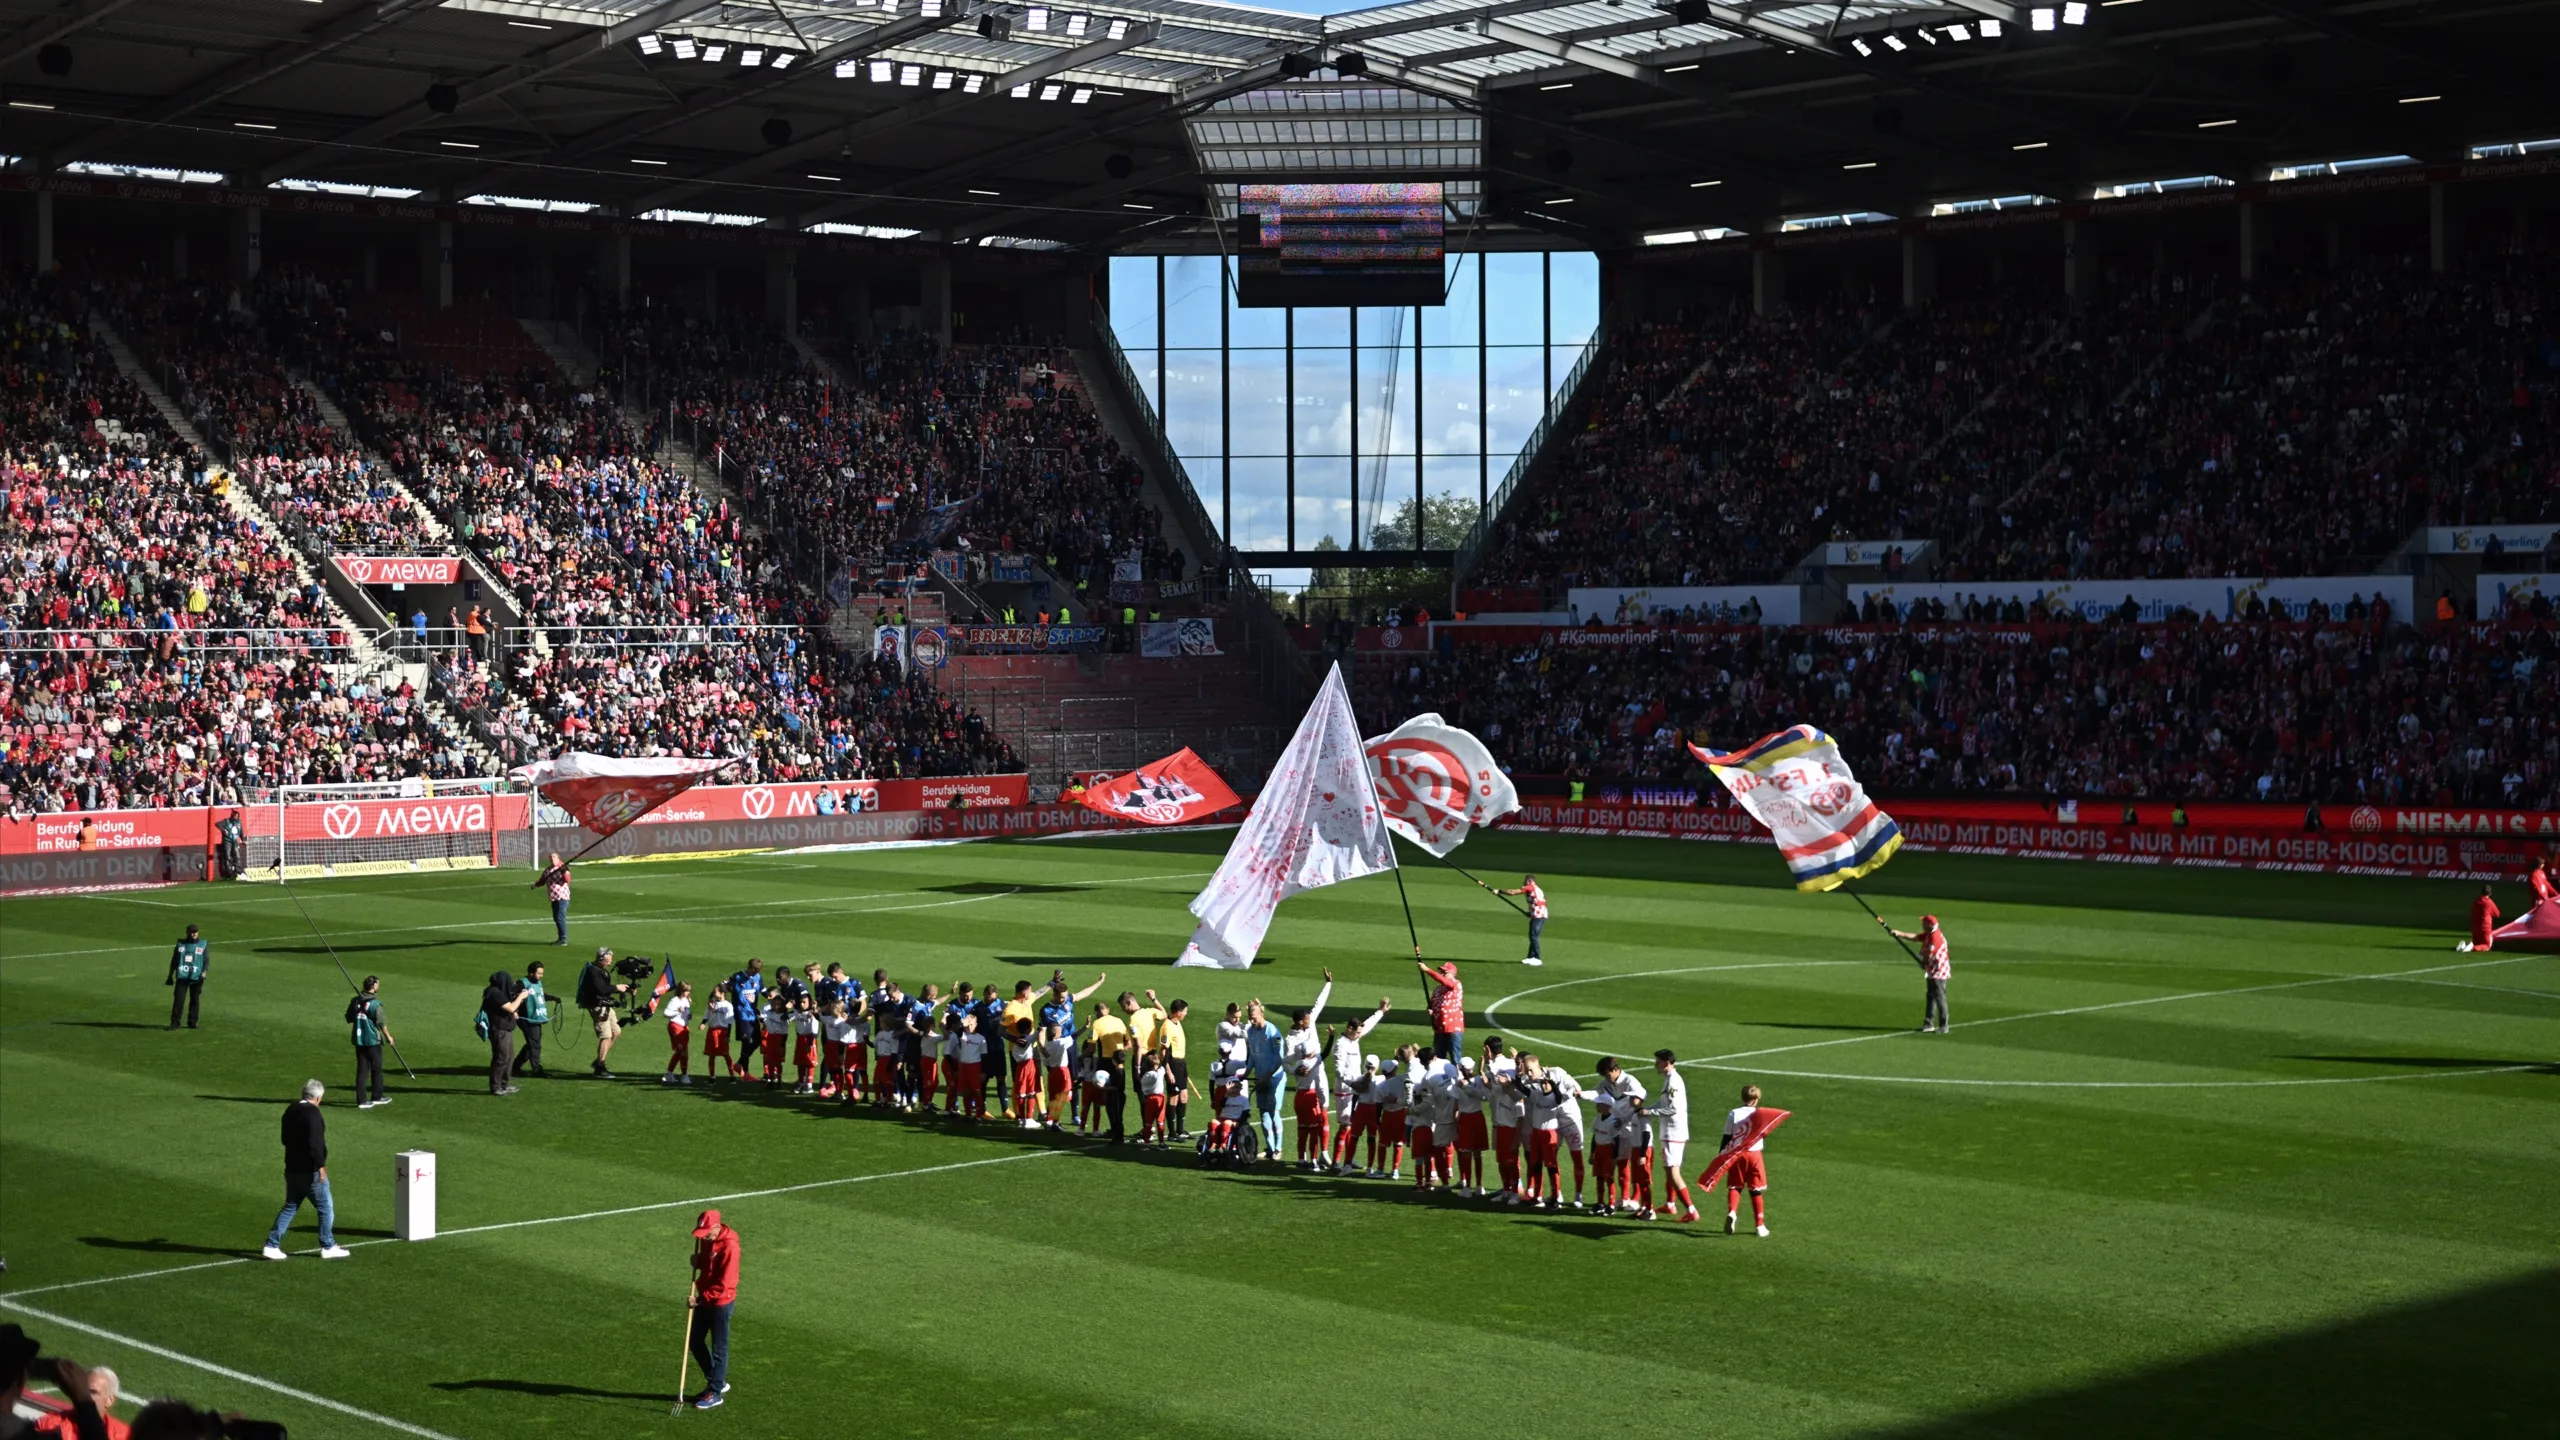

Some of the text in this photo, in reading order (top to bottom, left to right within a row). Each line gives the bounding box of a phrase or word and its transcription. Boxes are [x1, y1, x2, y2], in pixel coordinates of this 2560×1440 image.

[472, 583, 480, 598] H
[970, 629, 1032, 645] BRENZ
[922, 798, 939, 809] im
[1519, 805, 1553, 824] NUR
[1556, 807, 1585, 825] MIT
[1588, 808, 1624, 827] DEM
[656, 827, 712, 847] HAND
[719, 822, 739, 844] IN
[745, 820, 799, 842] HAND
[805, 819, 837, 840] MIT
[843, 817, 879, 837] DEN
[883, 814, 944, 835] PROFIS
[962, 812, 999, 831] NUR
[1004, 810, 1033, 829] MIT
[1039, 808, 1075, 827] DEM
[37, 838, 53, 850] im
[1955, 823, 1991, 844] MIT
[1995, 825, 2035, 846] DEN
[2040, 827, 2107, 850] PROFIS
[2129, 831, 2174, 853] NUR
[2179, 832, 2218, 856] MIT
[2223, 835, 2272, 858] DEM
[2276, 838, 2450, 866] 05ER-KIDSCLUB
[56, 856, 99, 880] MIT
[106, 853, 154, 876] DEN
